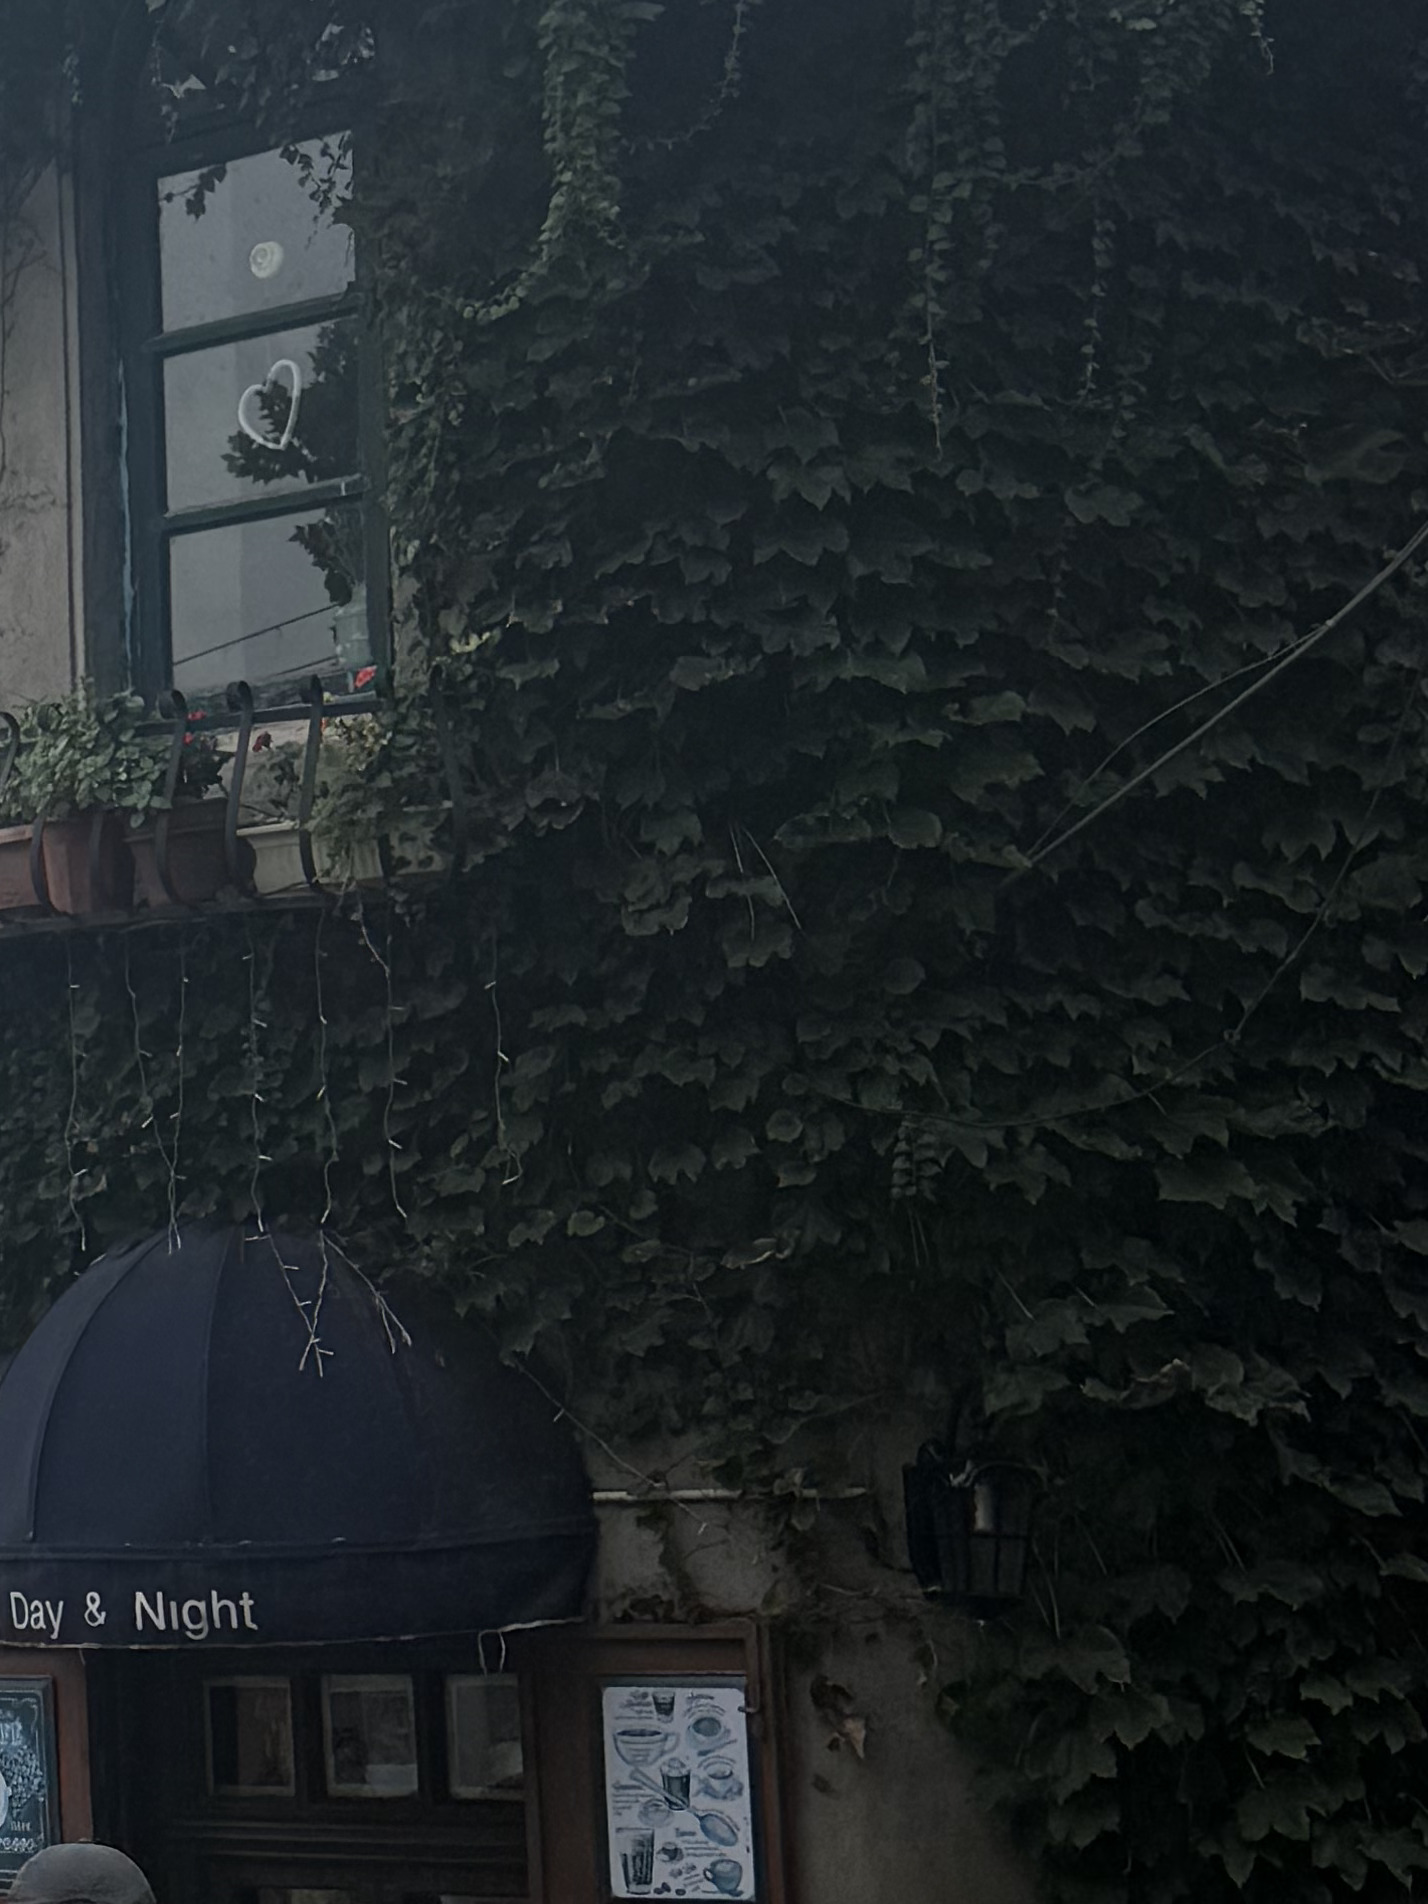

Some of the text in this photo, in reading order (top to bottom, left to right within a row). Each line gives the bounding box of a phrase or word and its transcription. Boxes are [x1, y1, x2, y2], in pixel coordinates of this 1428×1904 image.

[10, 1590, 258, 1640] Day & Night
